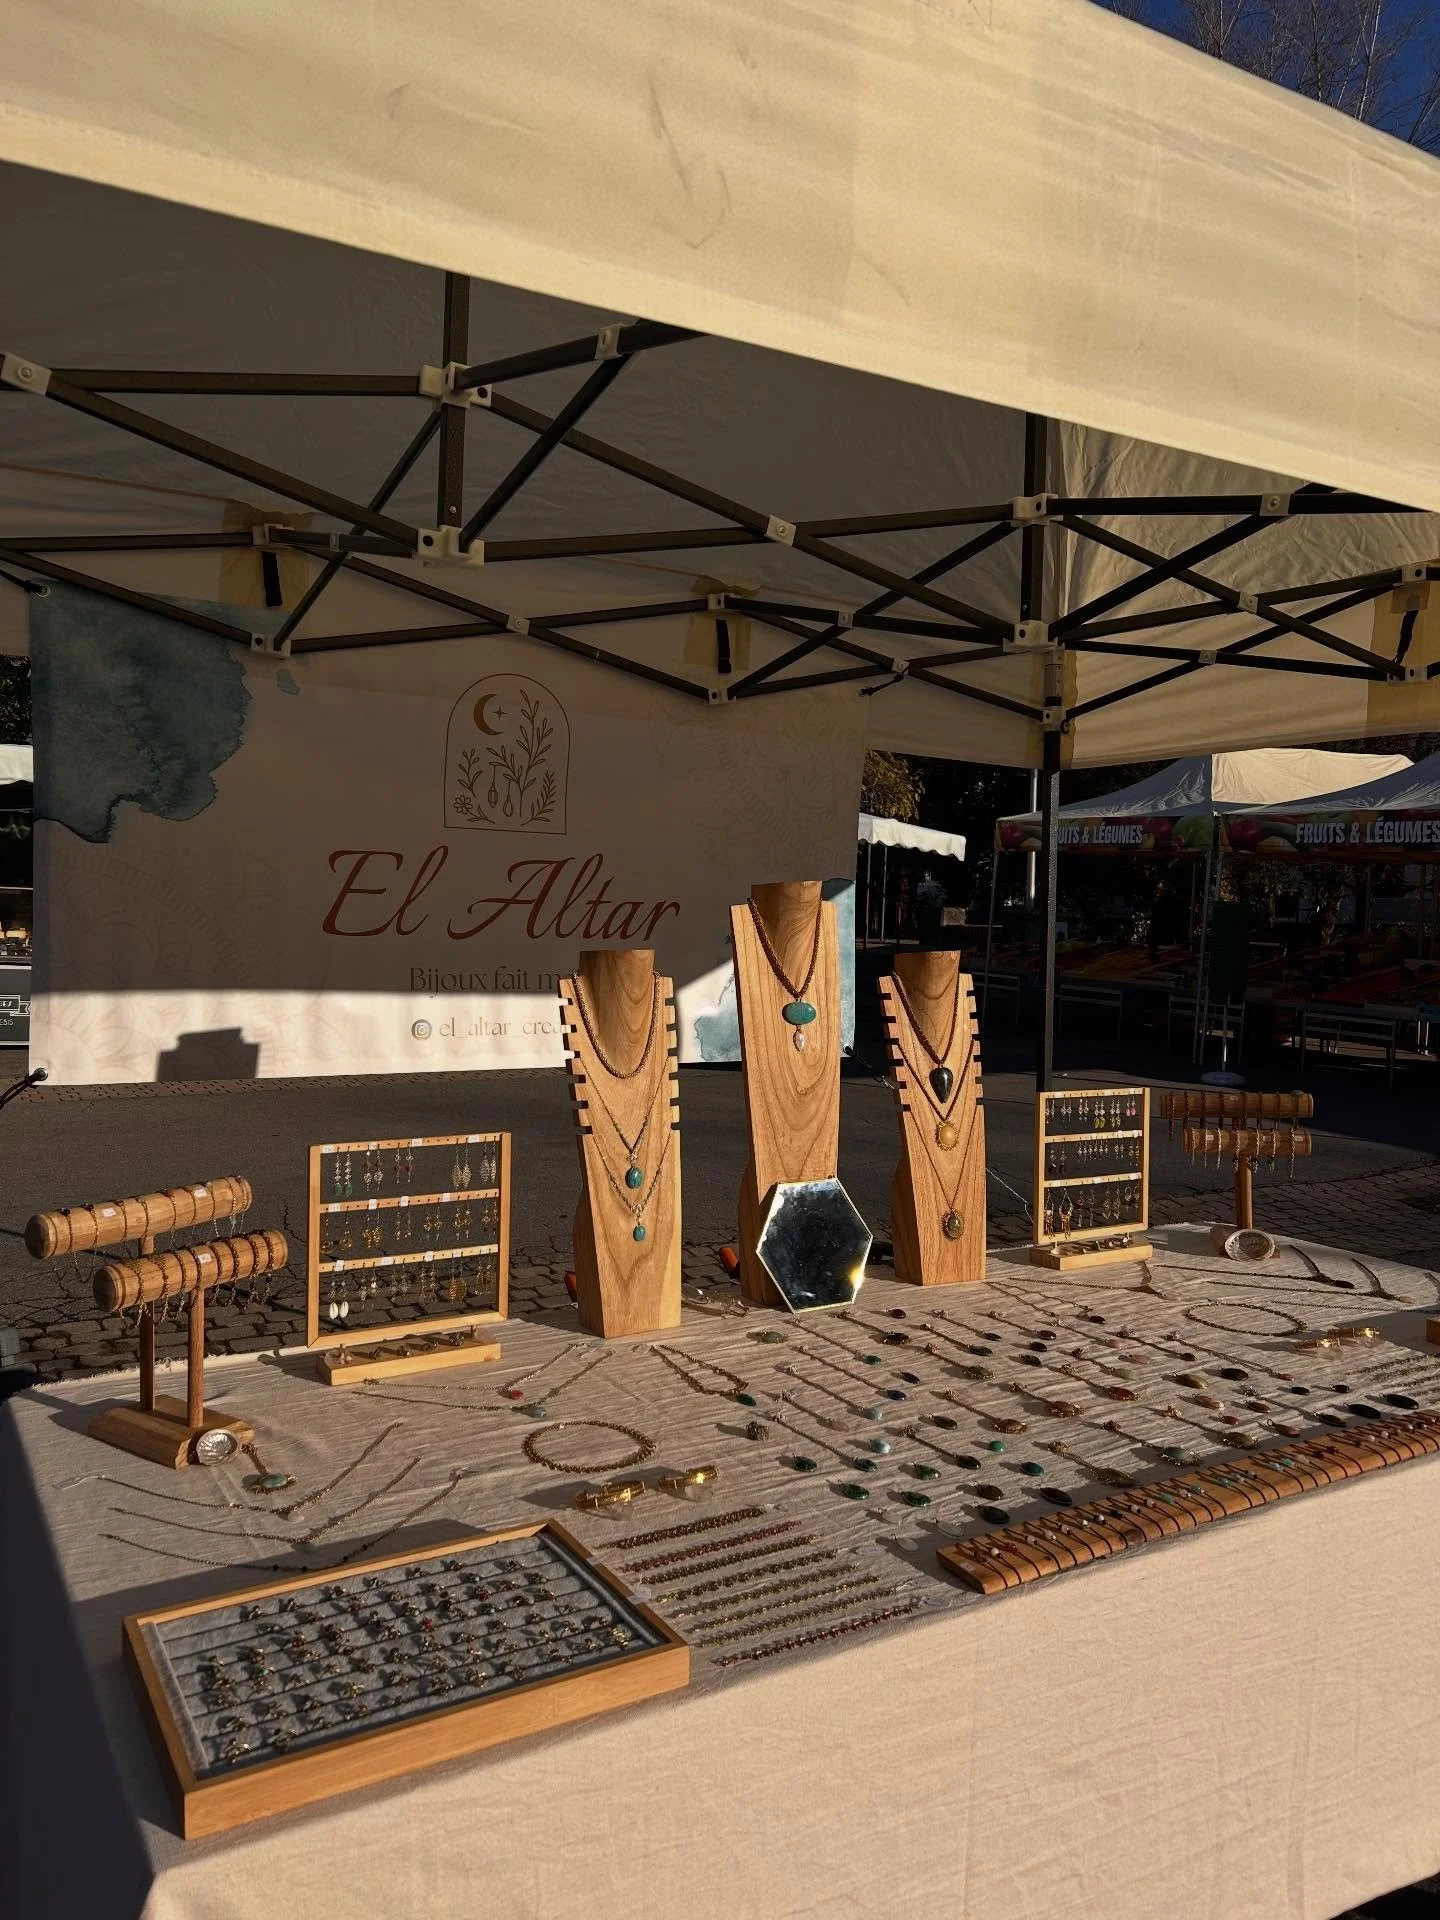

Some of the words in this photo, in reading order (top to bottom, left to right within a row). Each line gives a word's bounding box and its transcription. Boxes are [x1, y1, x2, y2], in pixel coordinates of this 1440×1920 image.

[1057, 826, 1080, 844] UITS
[1082, 825, 1090, 844] &
[1093, 821, 1144, 844] LÉGUMES
[1296, 821, 1346, 844] FRUITS
[1351, 821, 1361, 844] &
[1366, 816, 1440, 844] LÉGUMES
[322, 845, 449, 938] El
[447, 853, 681, 942] Altar
[410, 967, 487, 998] Bijoux
[494, 966, 528, 991] fait
